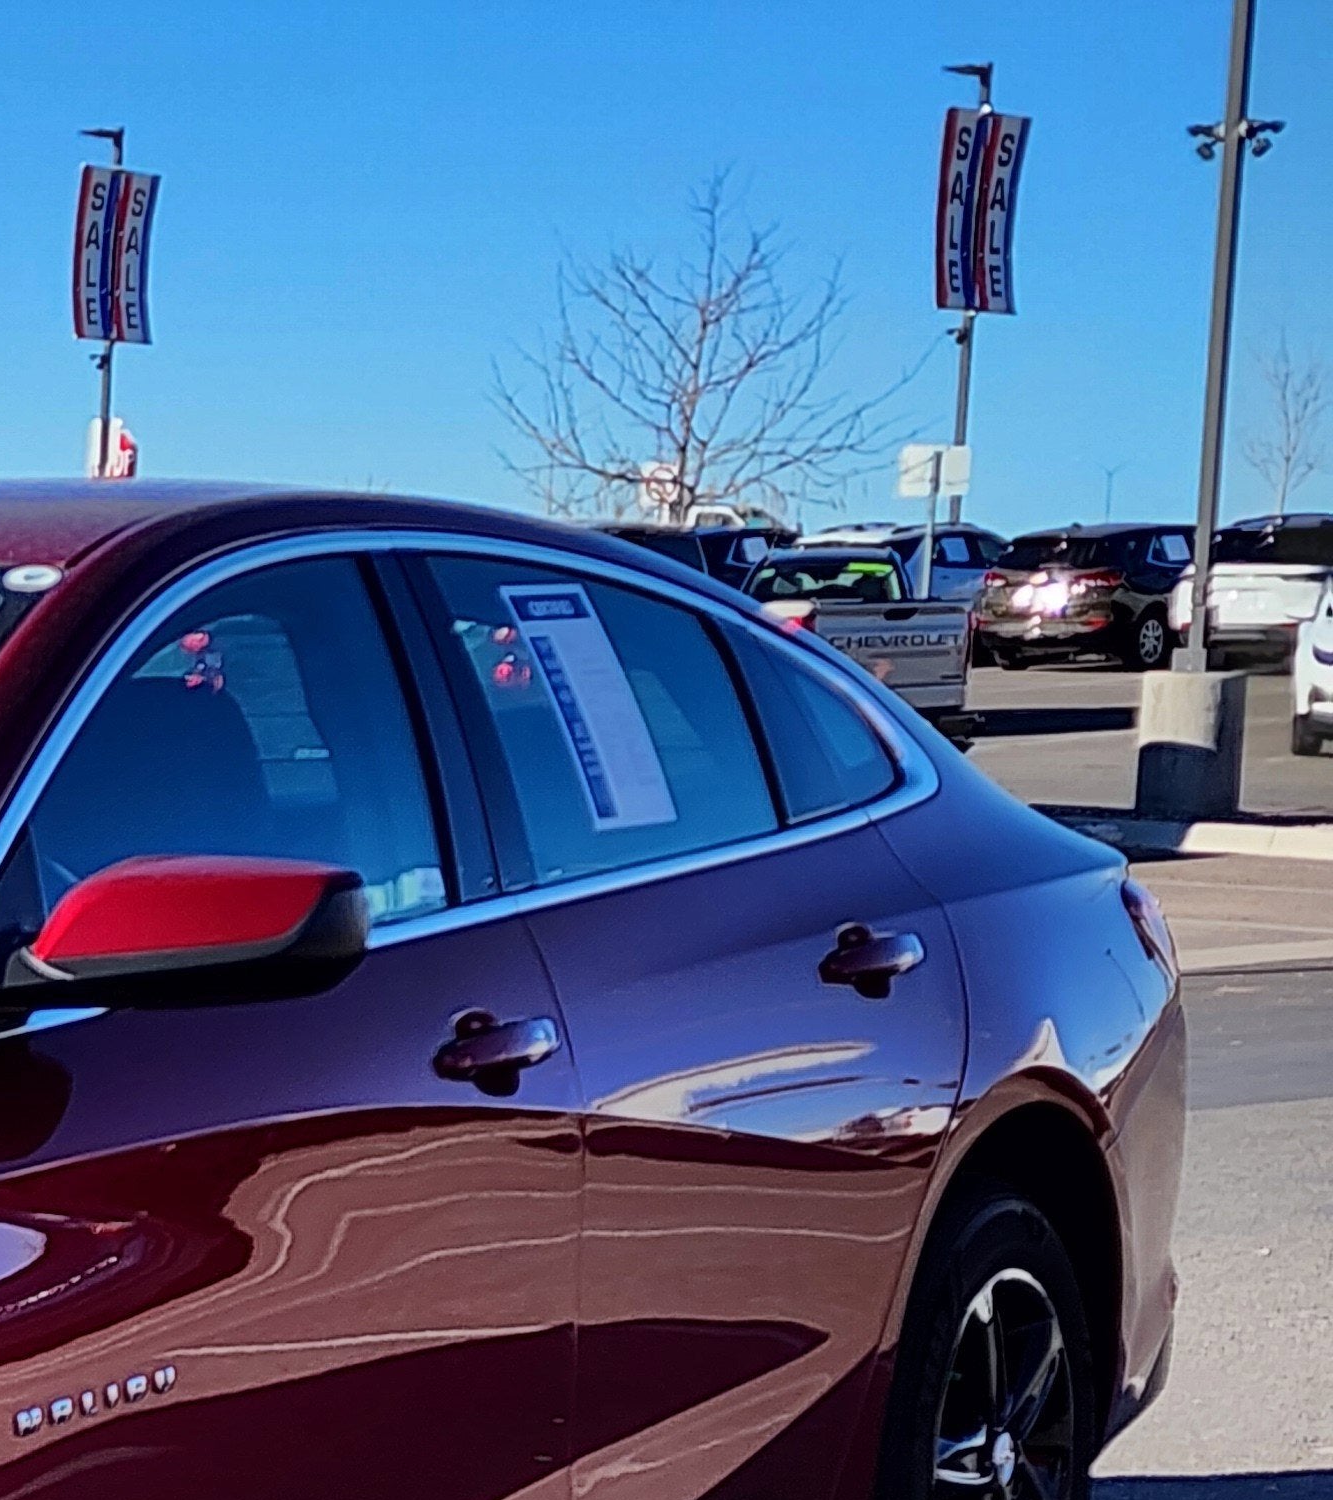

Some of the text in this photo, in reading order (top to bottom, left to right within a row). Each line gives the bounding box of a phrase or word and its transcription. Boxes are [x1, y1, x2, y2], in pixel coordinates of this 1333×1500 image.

[85, 182, 107, 326] SALE
[125, 188, 146, 329] SALE
[948, 126, 972, 293] SALE
[989, 133, 1015, 298] SALE
[831, 633, 960, 649] CHEVROLET
